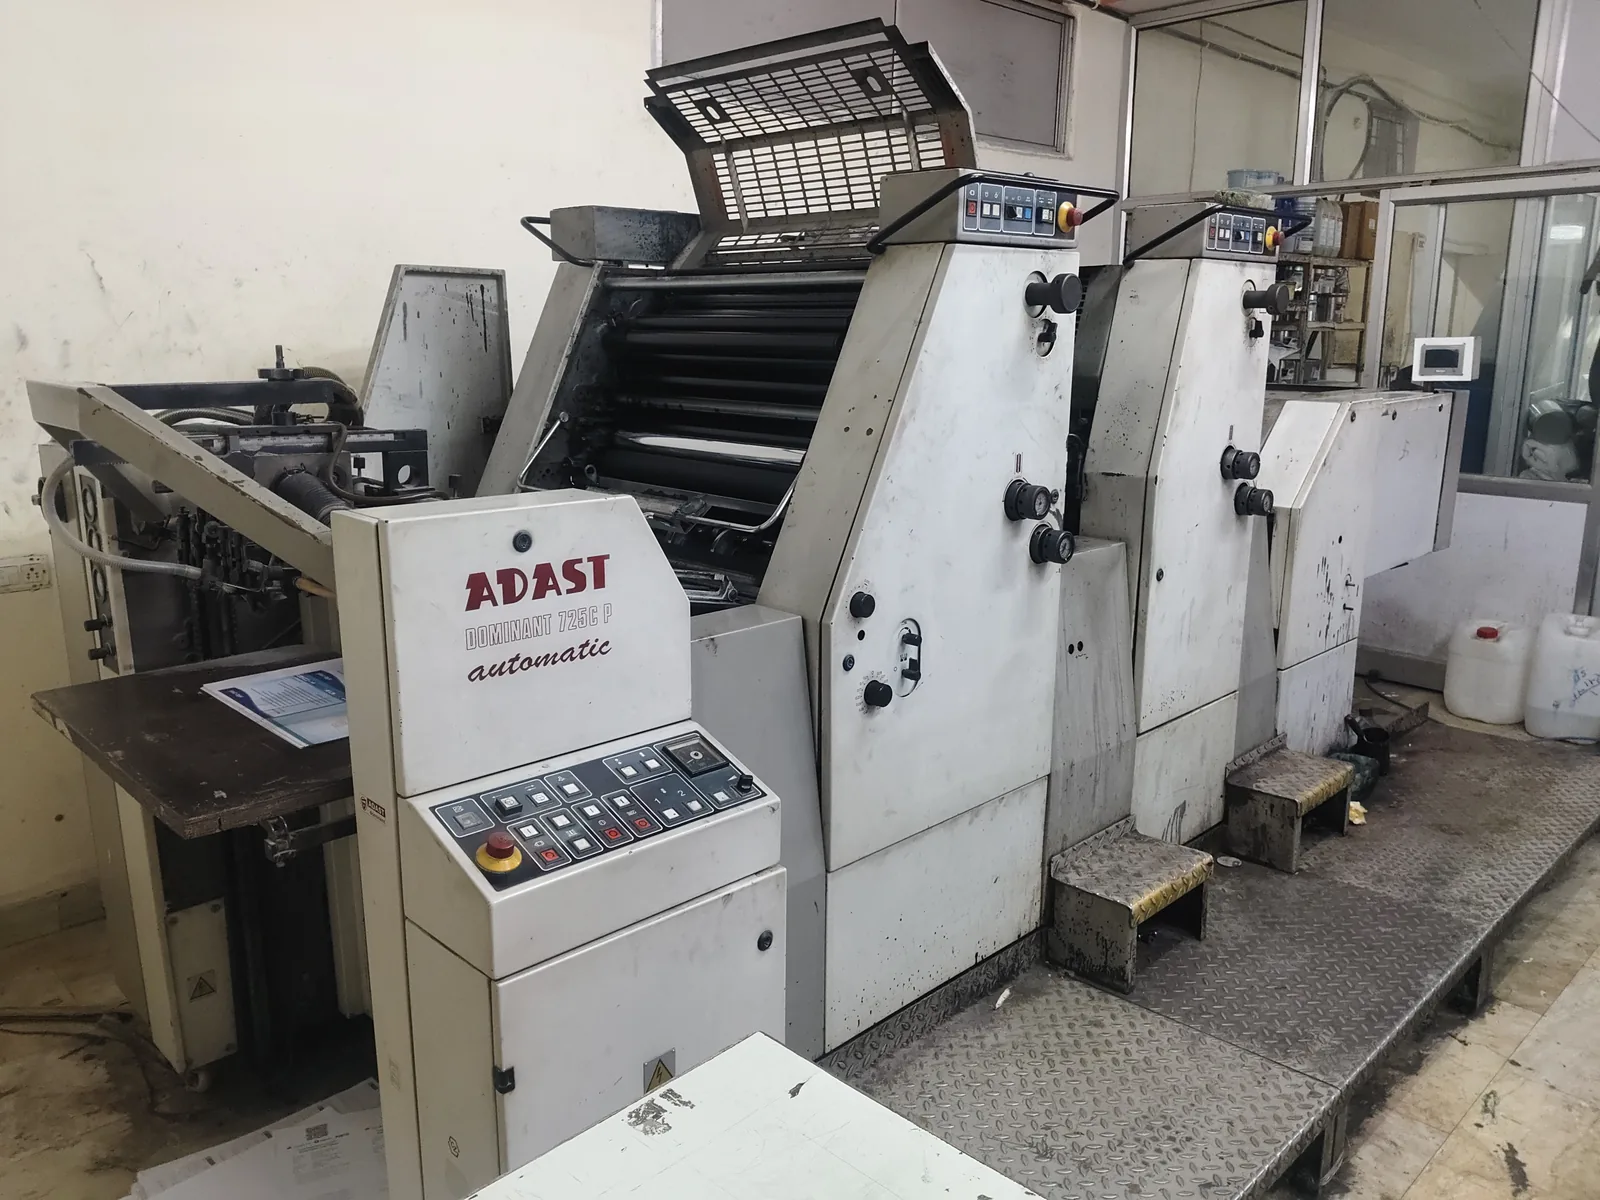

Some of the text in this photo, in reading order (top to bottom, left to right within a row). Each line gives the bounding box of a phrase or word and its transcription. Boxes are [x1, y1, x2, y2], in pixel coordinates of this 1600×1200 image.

[465, 554, 610, 612] ADAST
[465, 603, 613, 651] DOMINANT 725C P
[467, 638, 612, 683] automatic
